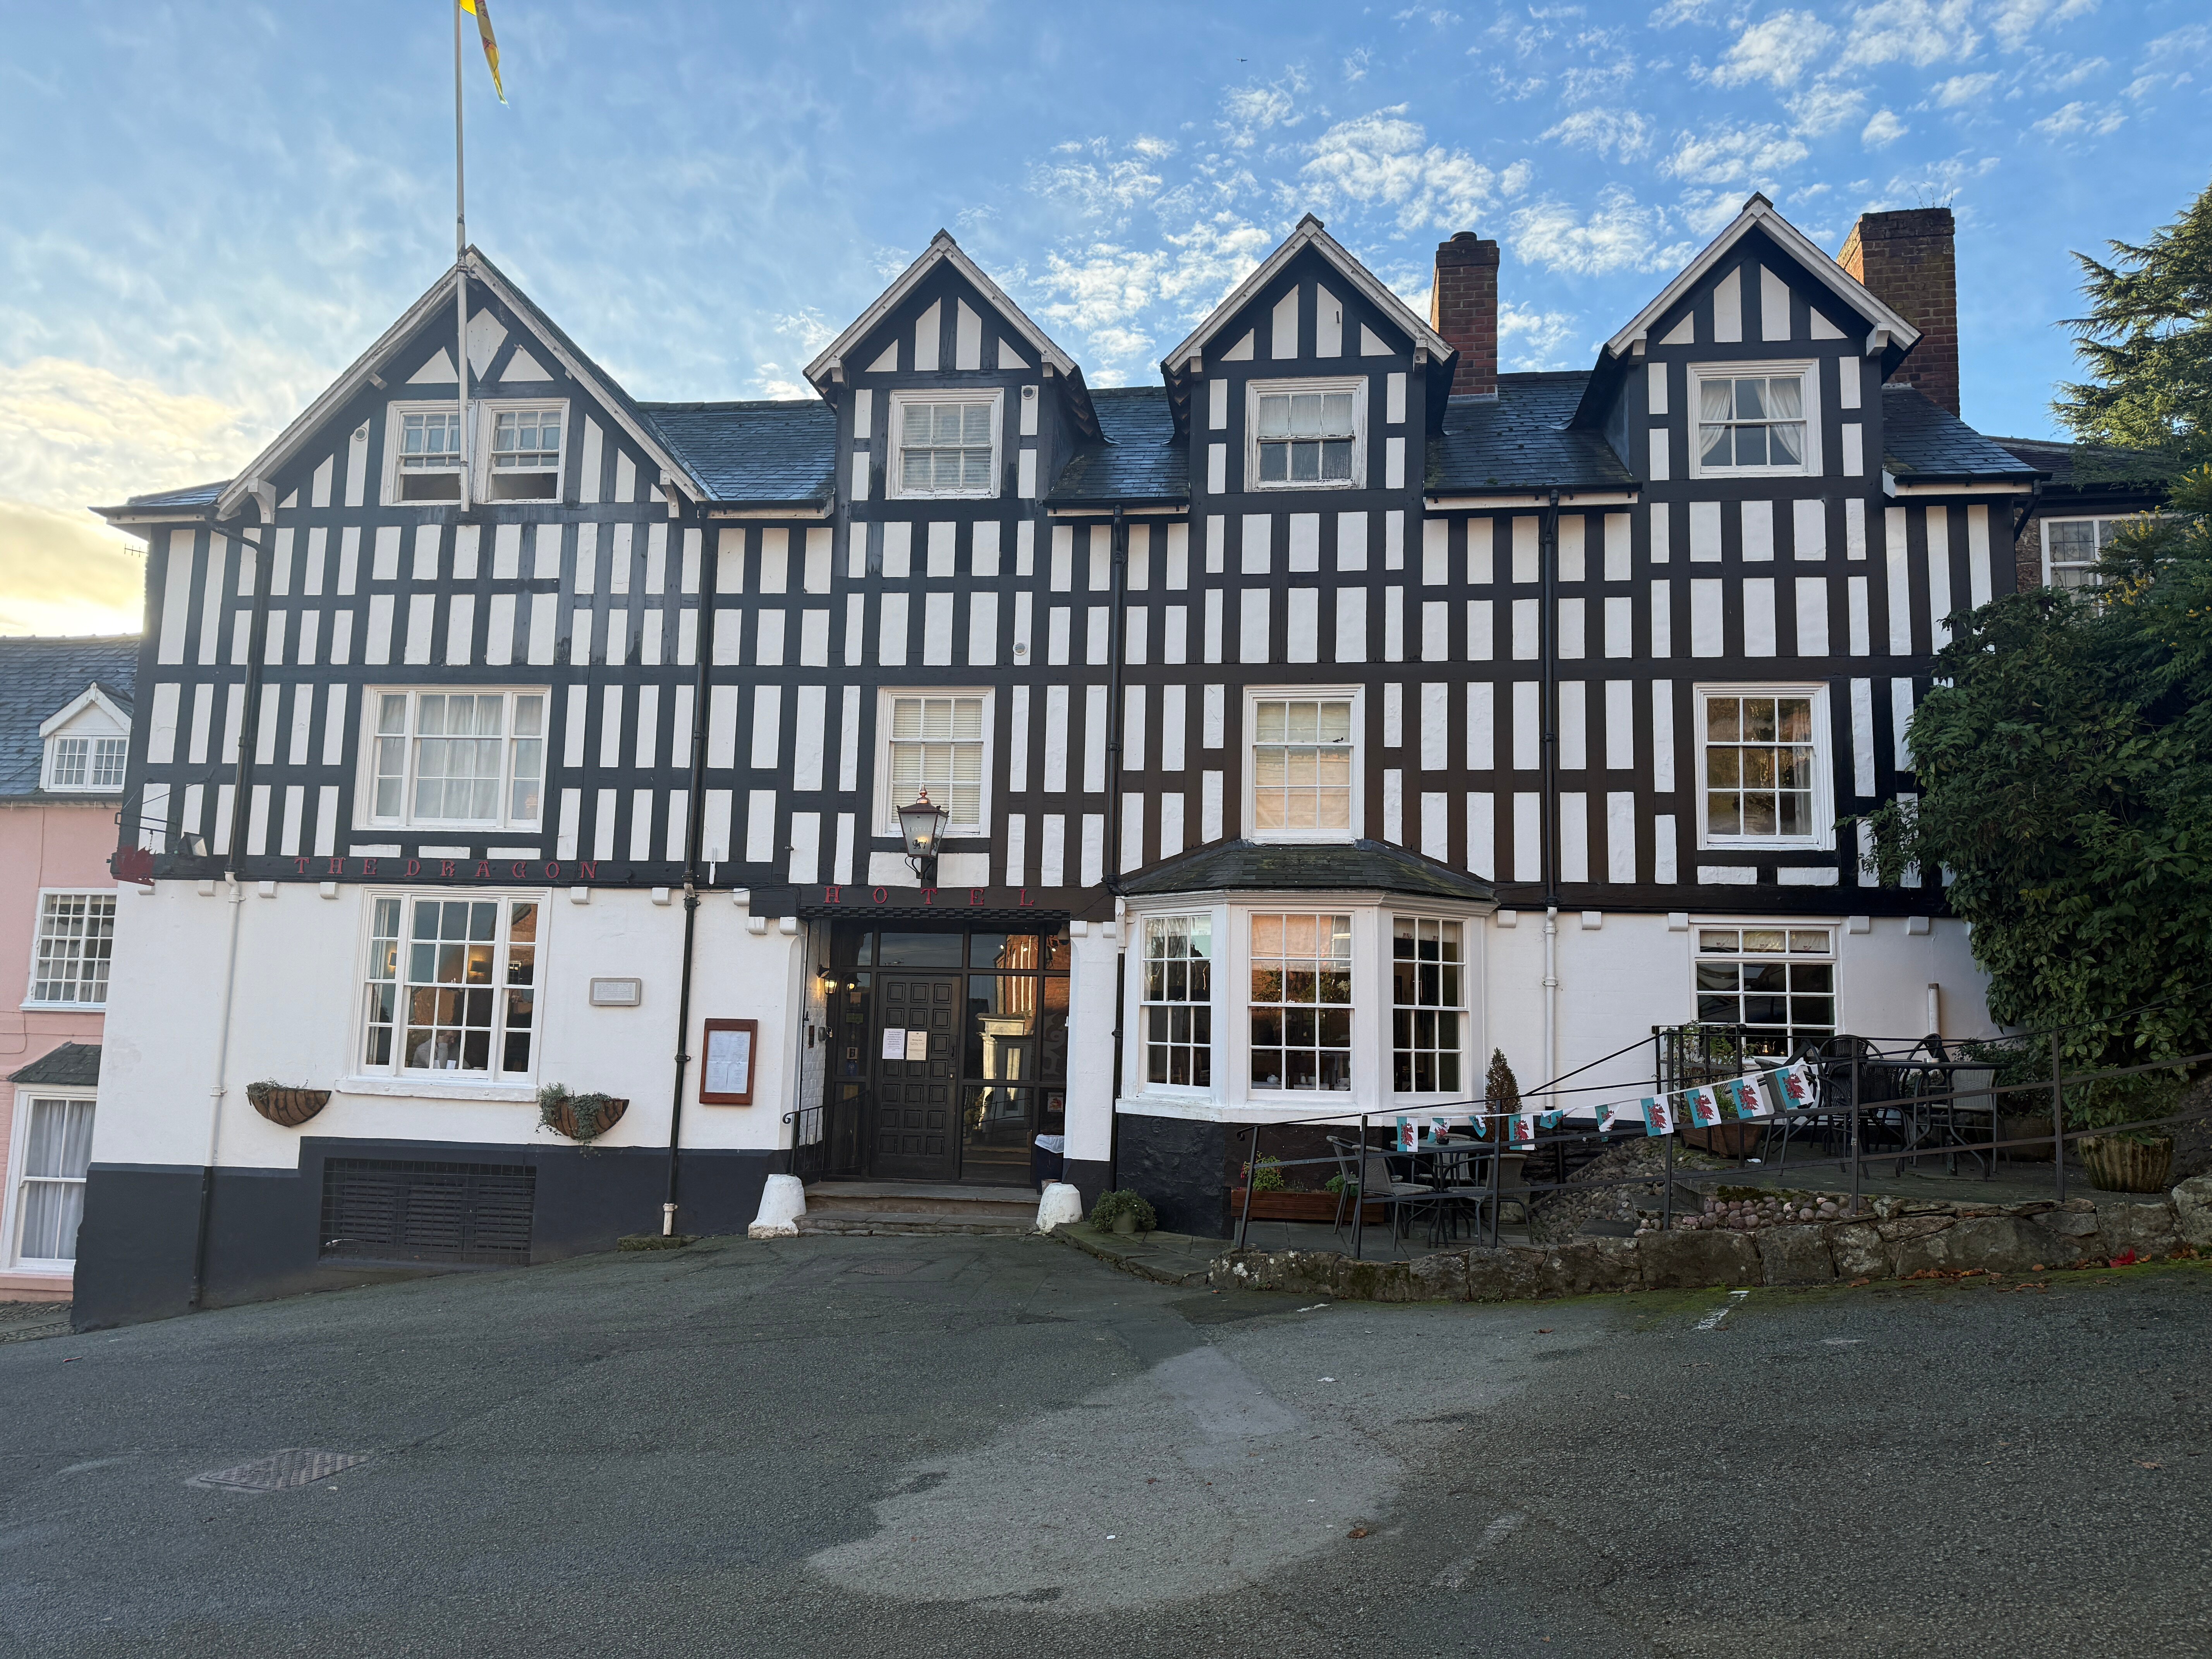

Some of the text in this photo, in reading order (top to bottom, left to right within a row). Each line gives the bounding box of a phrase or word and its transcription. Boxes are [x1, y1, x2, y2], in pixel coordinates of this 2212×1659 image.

[294, 857, 597, 879] THE DRAGON
[824, 886, 1034, 906] HOTEL
